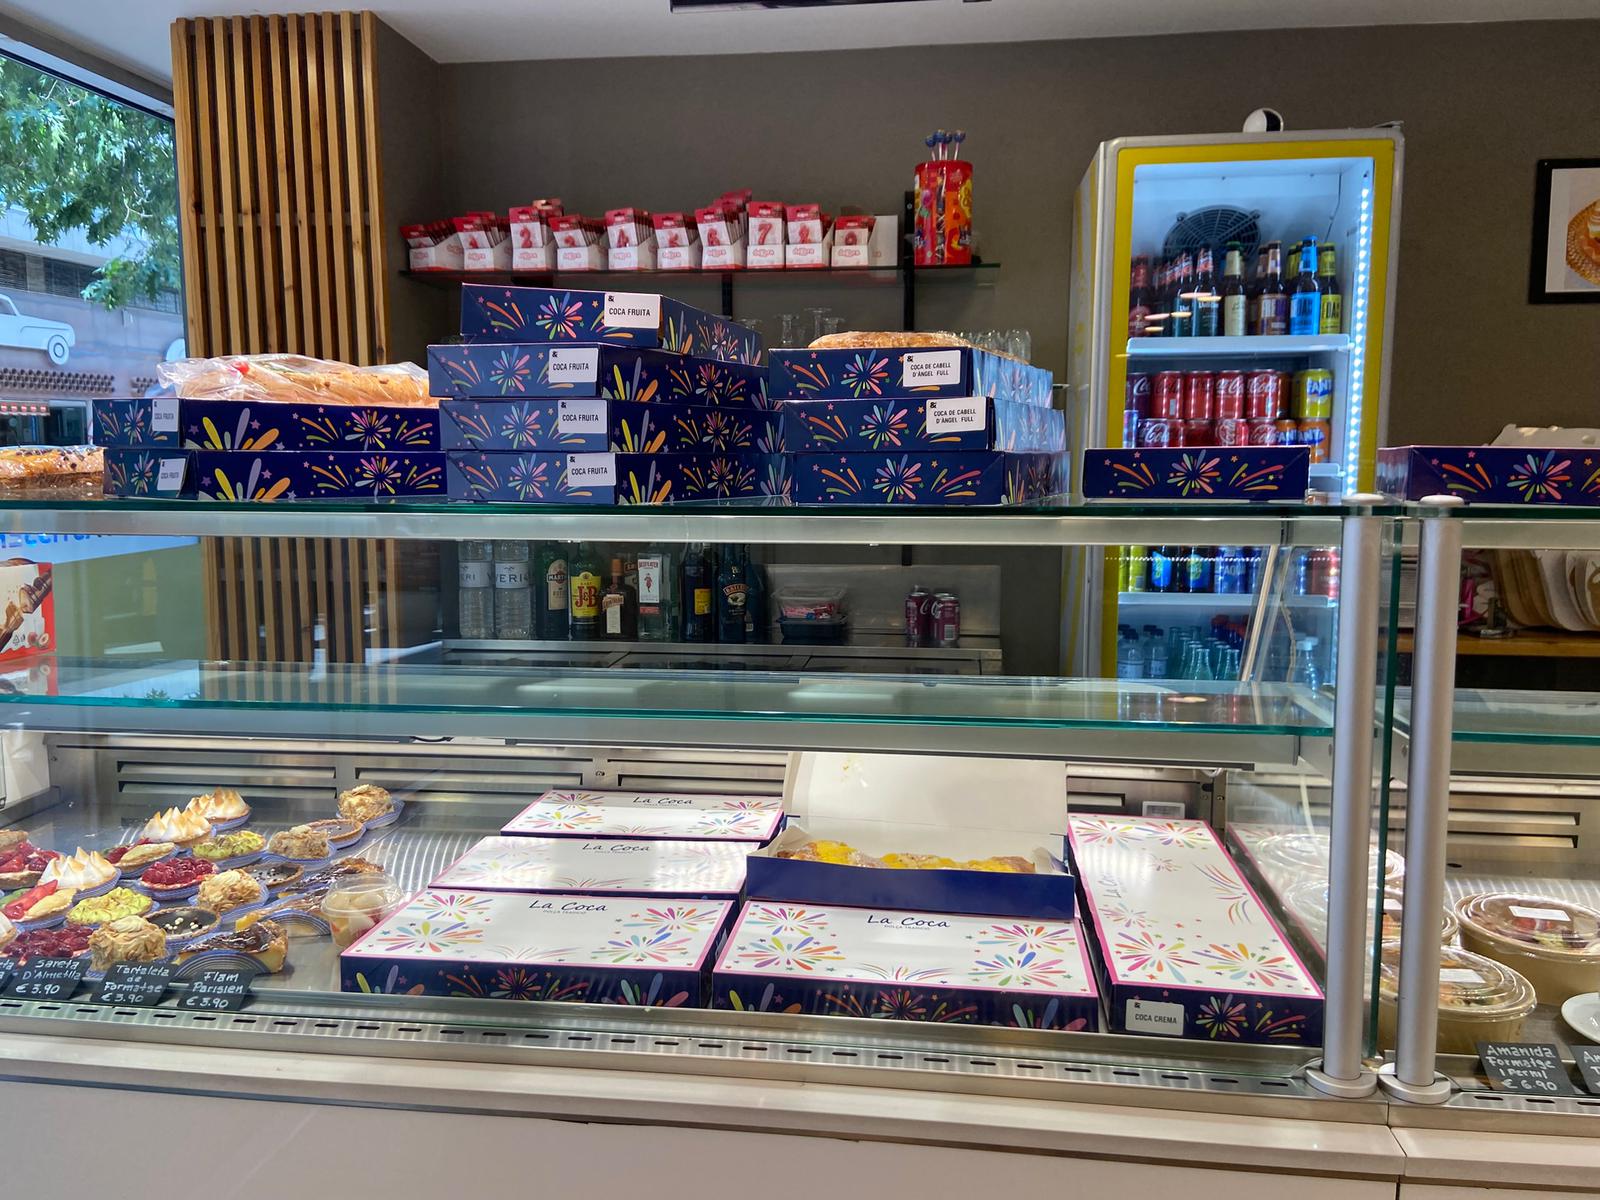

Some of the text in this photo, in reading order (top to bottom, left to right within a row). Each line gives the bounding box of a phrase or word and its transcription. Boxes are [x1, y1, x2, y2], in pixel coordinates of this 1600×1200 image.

[609, 308, 651, 316] COCA FRUITA
[553, 362, 589, 371] COCA FRUITA
[562, 414, 577, 422] COCA
[571, 467, 608, 476] COCA FRUITA
[497, 573, 528, 583] ERI
[633, 796, 693, 805] La Coca
[529, 900, 608, 911] La Coca
[867, 915, 951, 928] La Coca
[116, 965, 170, 977] Tartaleta
[203, 971, 239, 982] Flam
[15, 983, 29, 993] €
[104, 981, 163, 993] Formatge
[192, 981, 244, 994] Parisien
[101, 992, 113, 1001] €
[186, 996, 199, 1006] €
[1135, 1013, 1177, 1024] COCA CREMA
[1487, 1045, 1556, 1058] Amanida
[1485, 1056, 1556, 1070] Formatge
[1502, 1079, 1558, 1091] € 6.90
